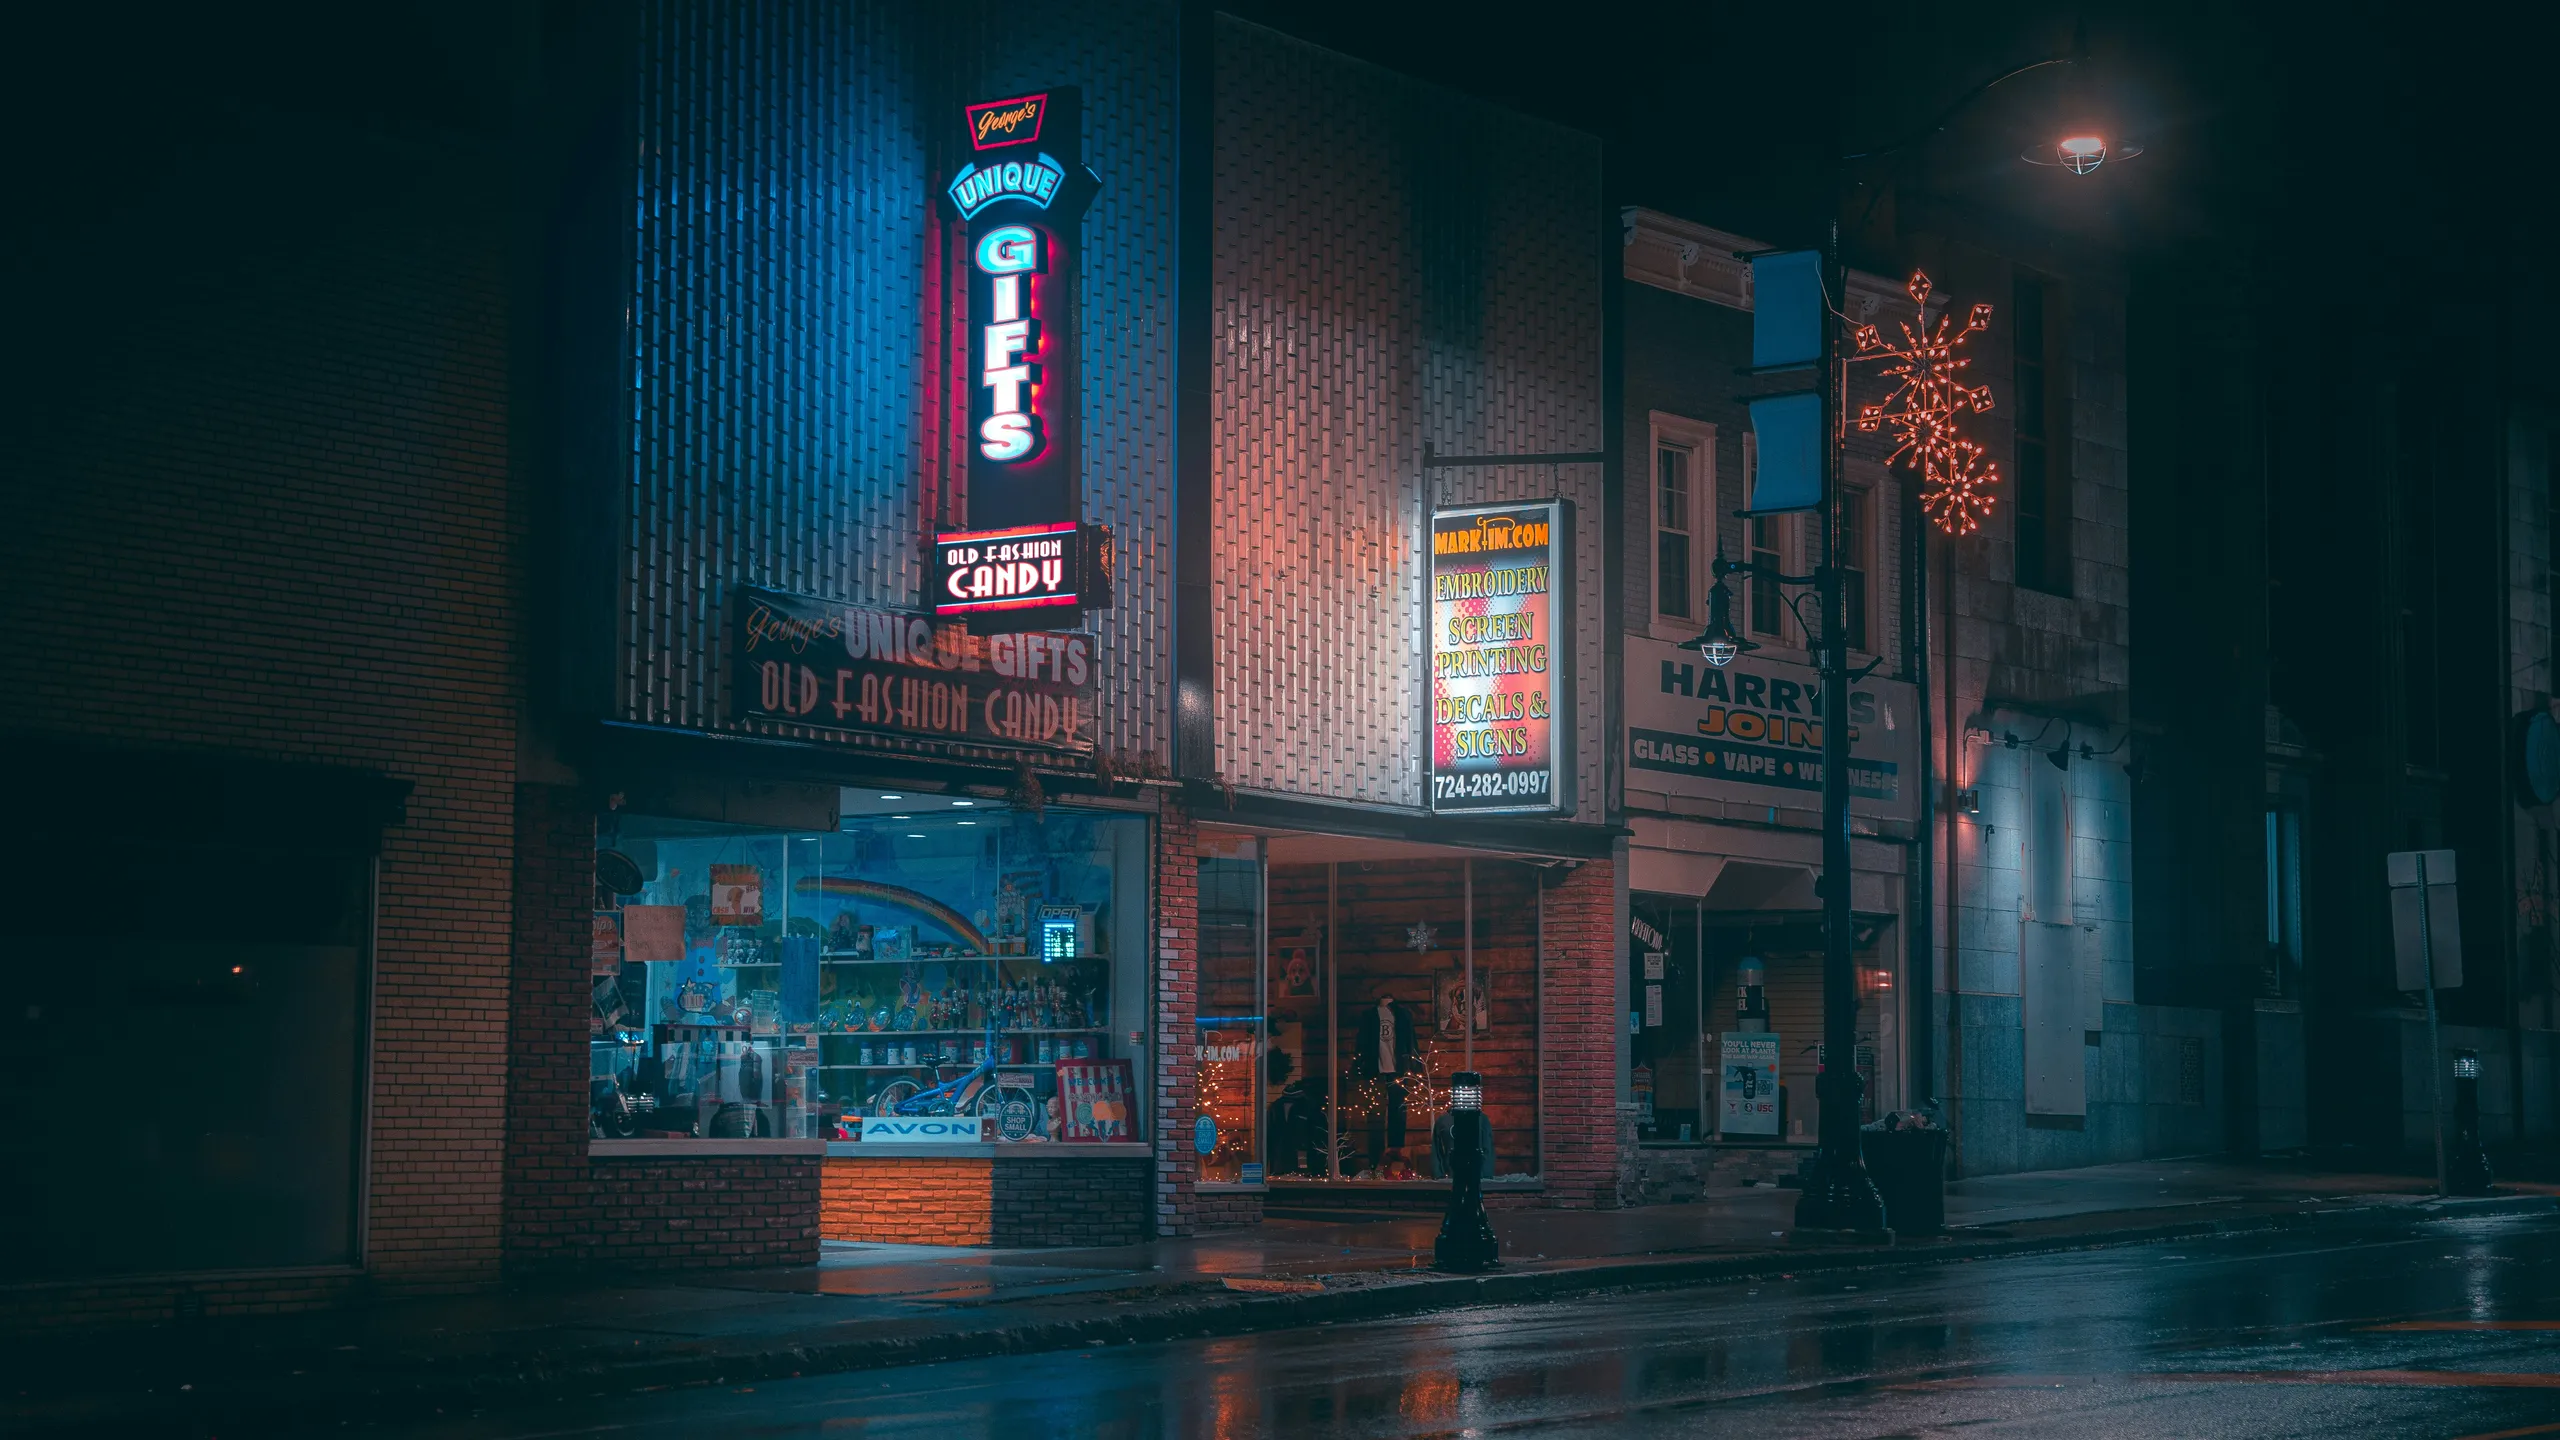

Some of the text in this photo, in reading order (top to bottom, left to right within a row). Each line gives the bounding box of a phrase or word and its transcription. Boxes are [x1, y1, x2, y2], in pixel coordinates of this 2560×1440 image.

[978, 102, 1037, 140] George's
[955, 161, 1058, 208] UNIQUE
[976, 225, 1037, 462] GIFTS
[947, 540, 1062, 566] OLD FASHION
[947, 559, 1063, 598] CANDY
[1435, 565, 1549, 601] EMBROIDERY
[1448, 612, 1533, 645] SCREEN
[745, 605, 841, 655] George's
[844, 609, 980, 673] UNIQUE
[991, 633, 1088, 686] GIFTS
[1437, 644, 1548, 679] PRINTING
[761, 661, 818, 714] OLD
[831, 669, 967, 732] FASHION
[985, 688, 1079, 743] CANDY
[1436, 691, 1549, 724] DECALS &
[1661, 660, 1875, 724] HARRYS
[1457, 727, 1528, 757] SIGNS
[1633, 739, 1898, 790] GLASS VAPE WENESS
[1435, 771, 1549, 799] 724-282-0997
[1040, 907, 1080, 920] OPEN
[1750, 1041, 1776, 1049] NEVER
[1006, 1116, 1026, 1124] SHOP
[1756, 1104, 1774, 1113] USC
[866, 1122, 976, 1136] AVON
[1005, 1123, 1027, 1131] SMALL
